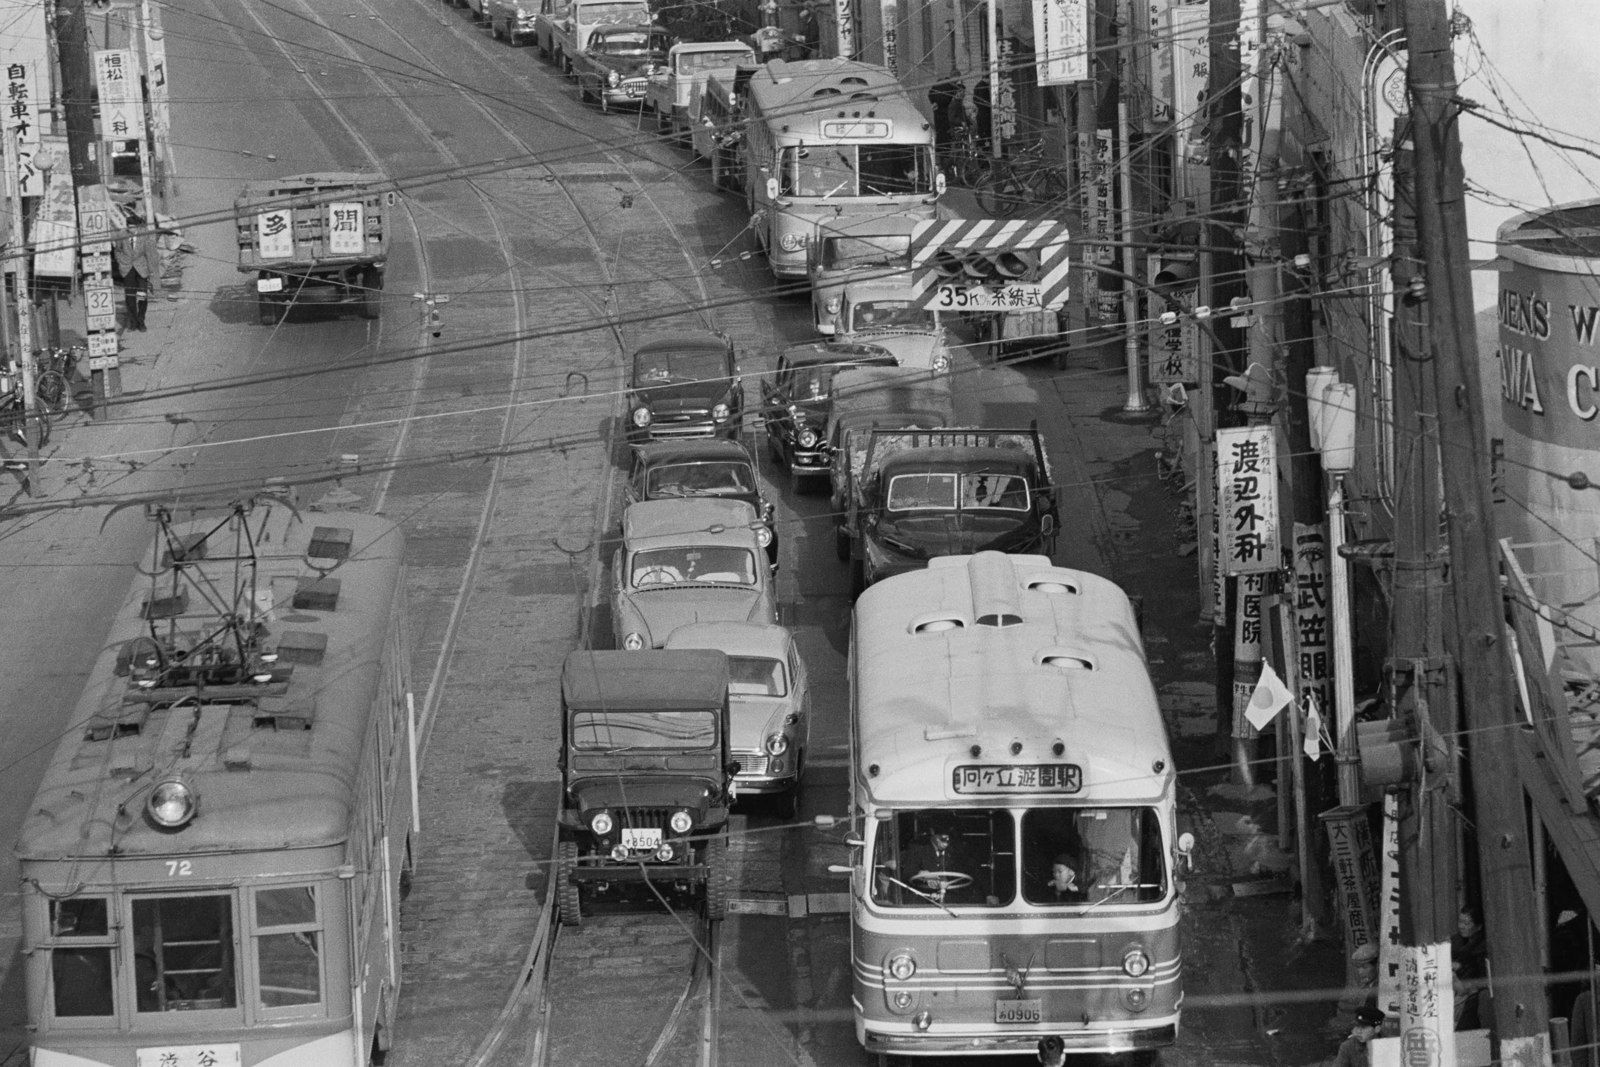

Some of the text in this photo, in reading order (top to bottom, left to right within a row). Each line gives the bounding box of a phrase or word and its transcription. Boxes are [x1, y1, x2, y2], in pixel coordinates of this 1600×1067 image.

[86, 214, 103, 230] 40
[263, 214, 287, 236] 多
[89, 291, 109, 309] 32
[991, 286, 1041, 307] 系統式
[1231, 439, 1267, 563] 渡辺外科
[1297, 572, 1328, 718] 武笠眼科
[165, 860, 192, 877] 72
[1422, 958, 1439, 1018] 三軒茶屋
